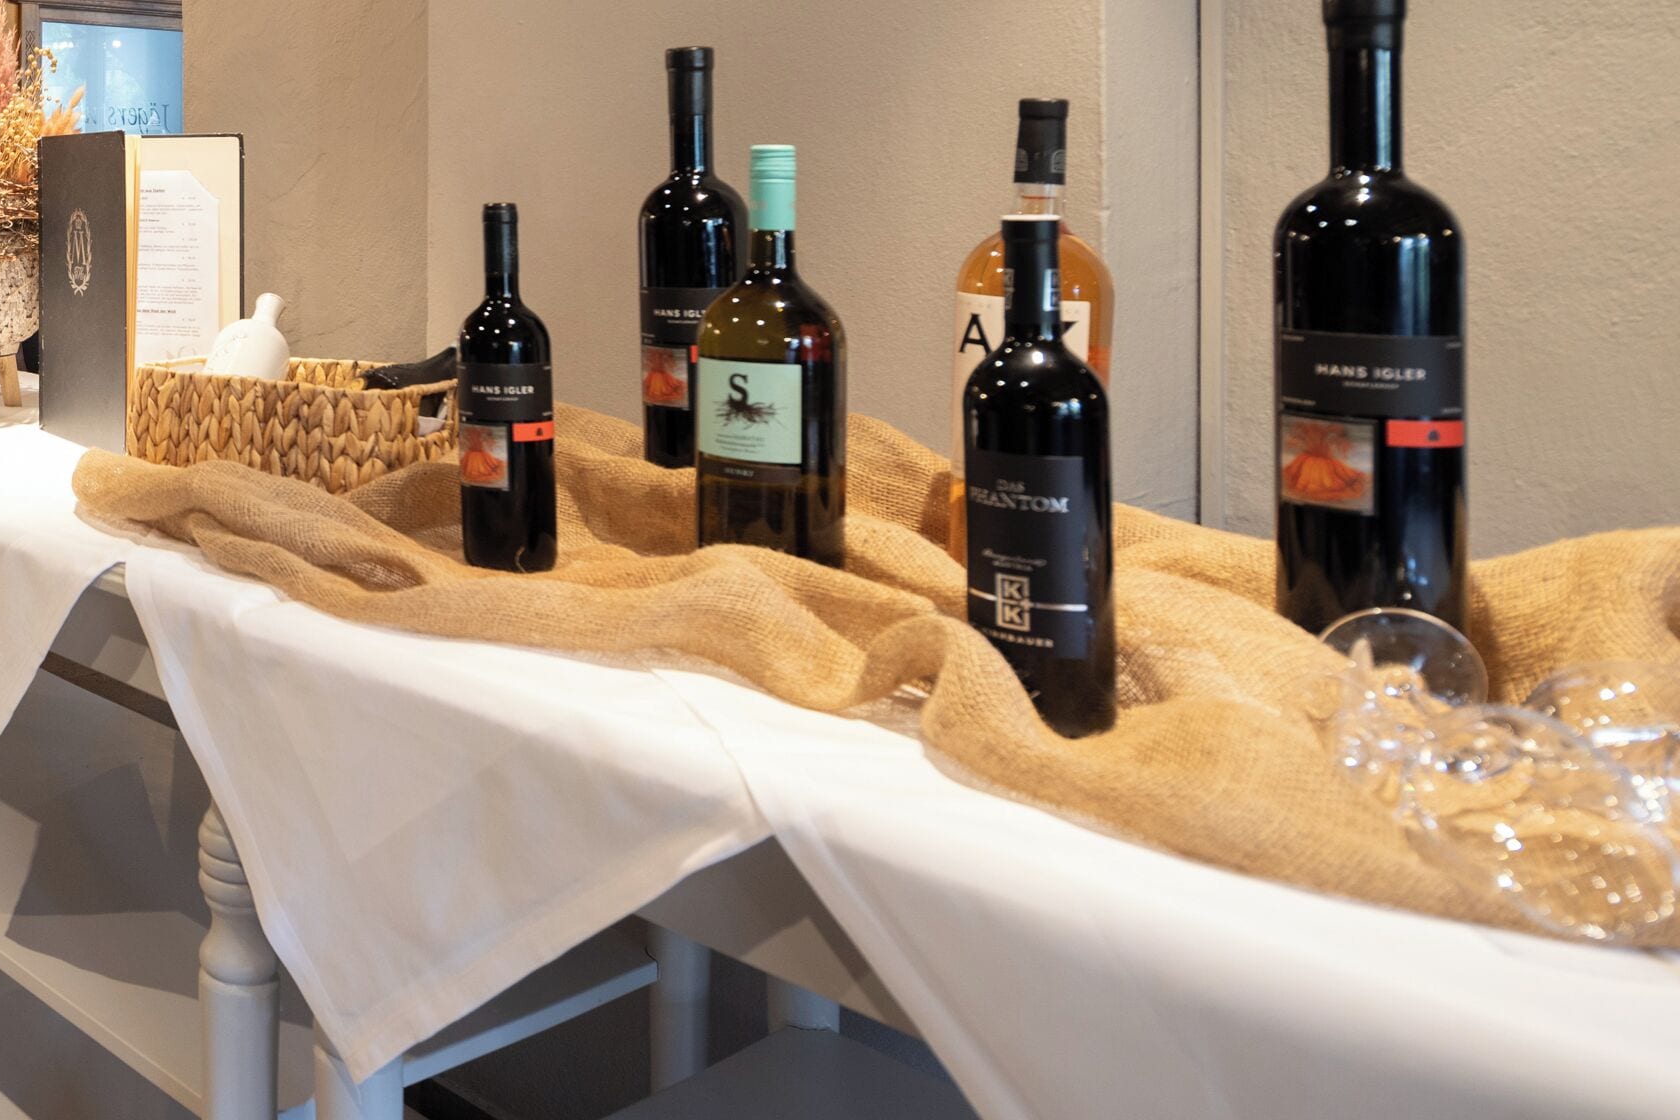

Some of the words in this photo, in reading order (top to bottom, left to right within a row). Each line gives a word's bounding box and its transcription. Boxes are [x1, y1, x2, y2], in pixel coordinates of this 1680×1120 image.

[653, 309, 680, 317] HANS
[683, 309, 706, 318] IGL
[1315, 364, 1368, 379] HANS
[1373, 366, 1427, 381] IGLER
[471, 385, 501, 395] HANS
[503, 385, 535, 395] IGLER
[969, 485, 1070, 514] PHANTOM
[1003, 579, 1022, 600] K
[1003, 605, 1022, 624] K
